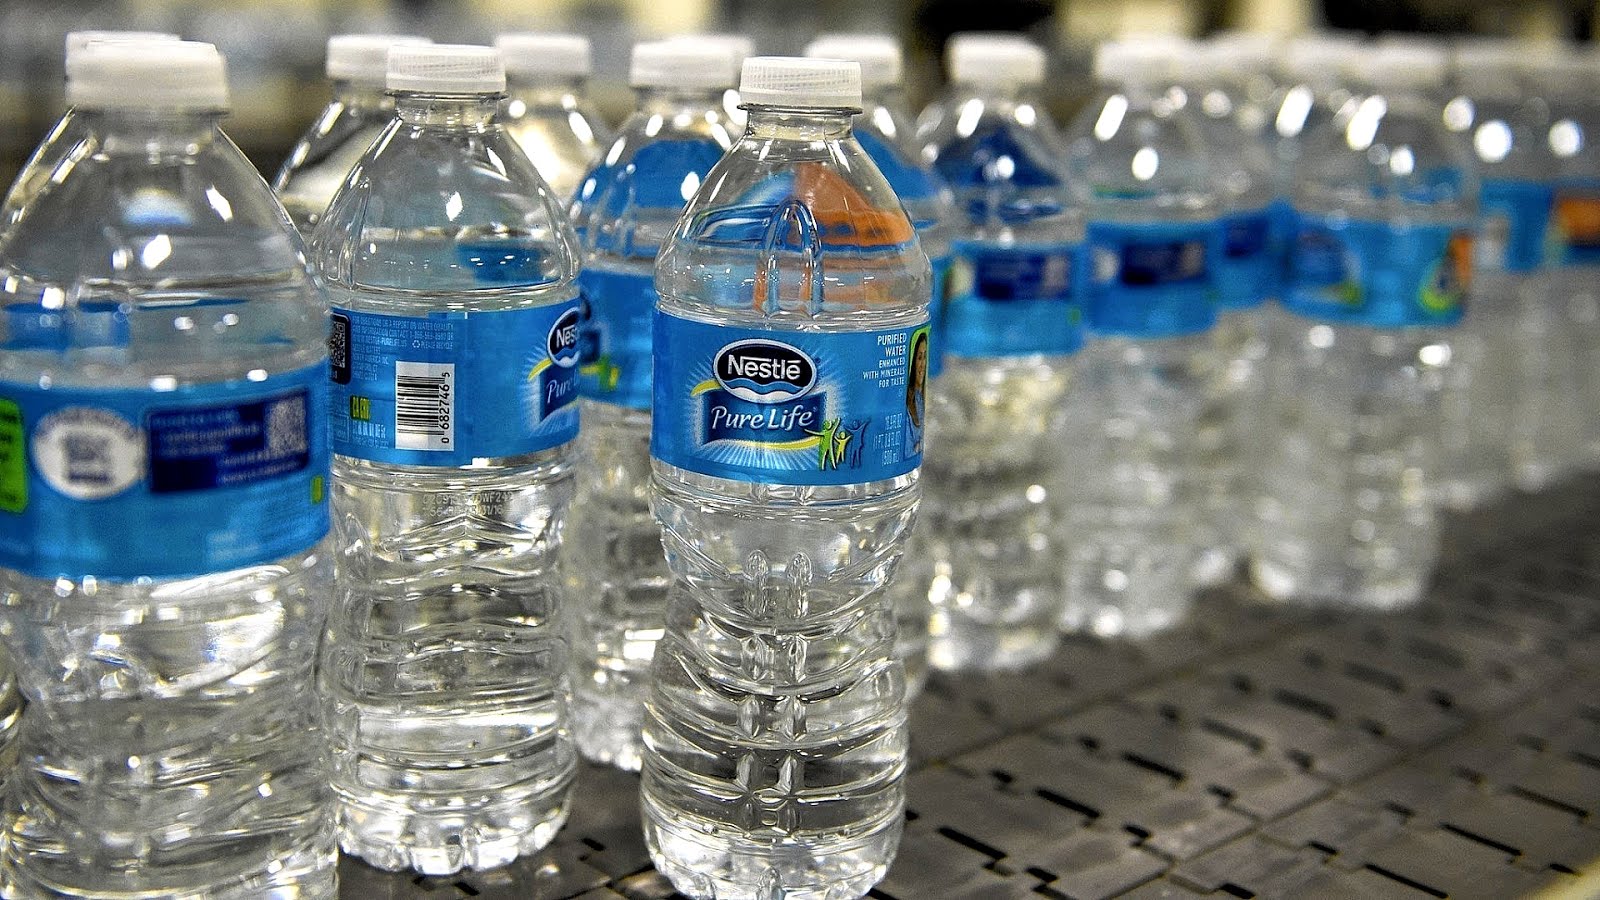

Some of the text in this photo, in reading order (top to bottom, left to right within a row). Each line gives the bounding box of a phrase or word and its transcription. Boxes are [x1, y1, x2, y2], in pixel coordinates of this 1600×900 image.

[877, 333, 907, 346] PURIFIED
[885, 345, 906, 357] WATER
[879, 357, 906, 369] ENHANCED
[862, 367, 905, 380] WITH MINERALS
[878, 376, 905, 388] FOR TASTE
[711, 404, 815, 431] Pure Life
